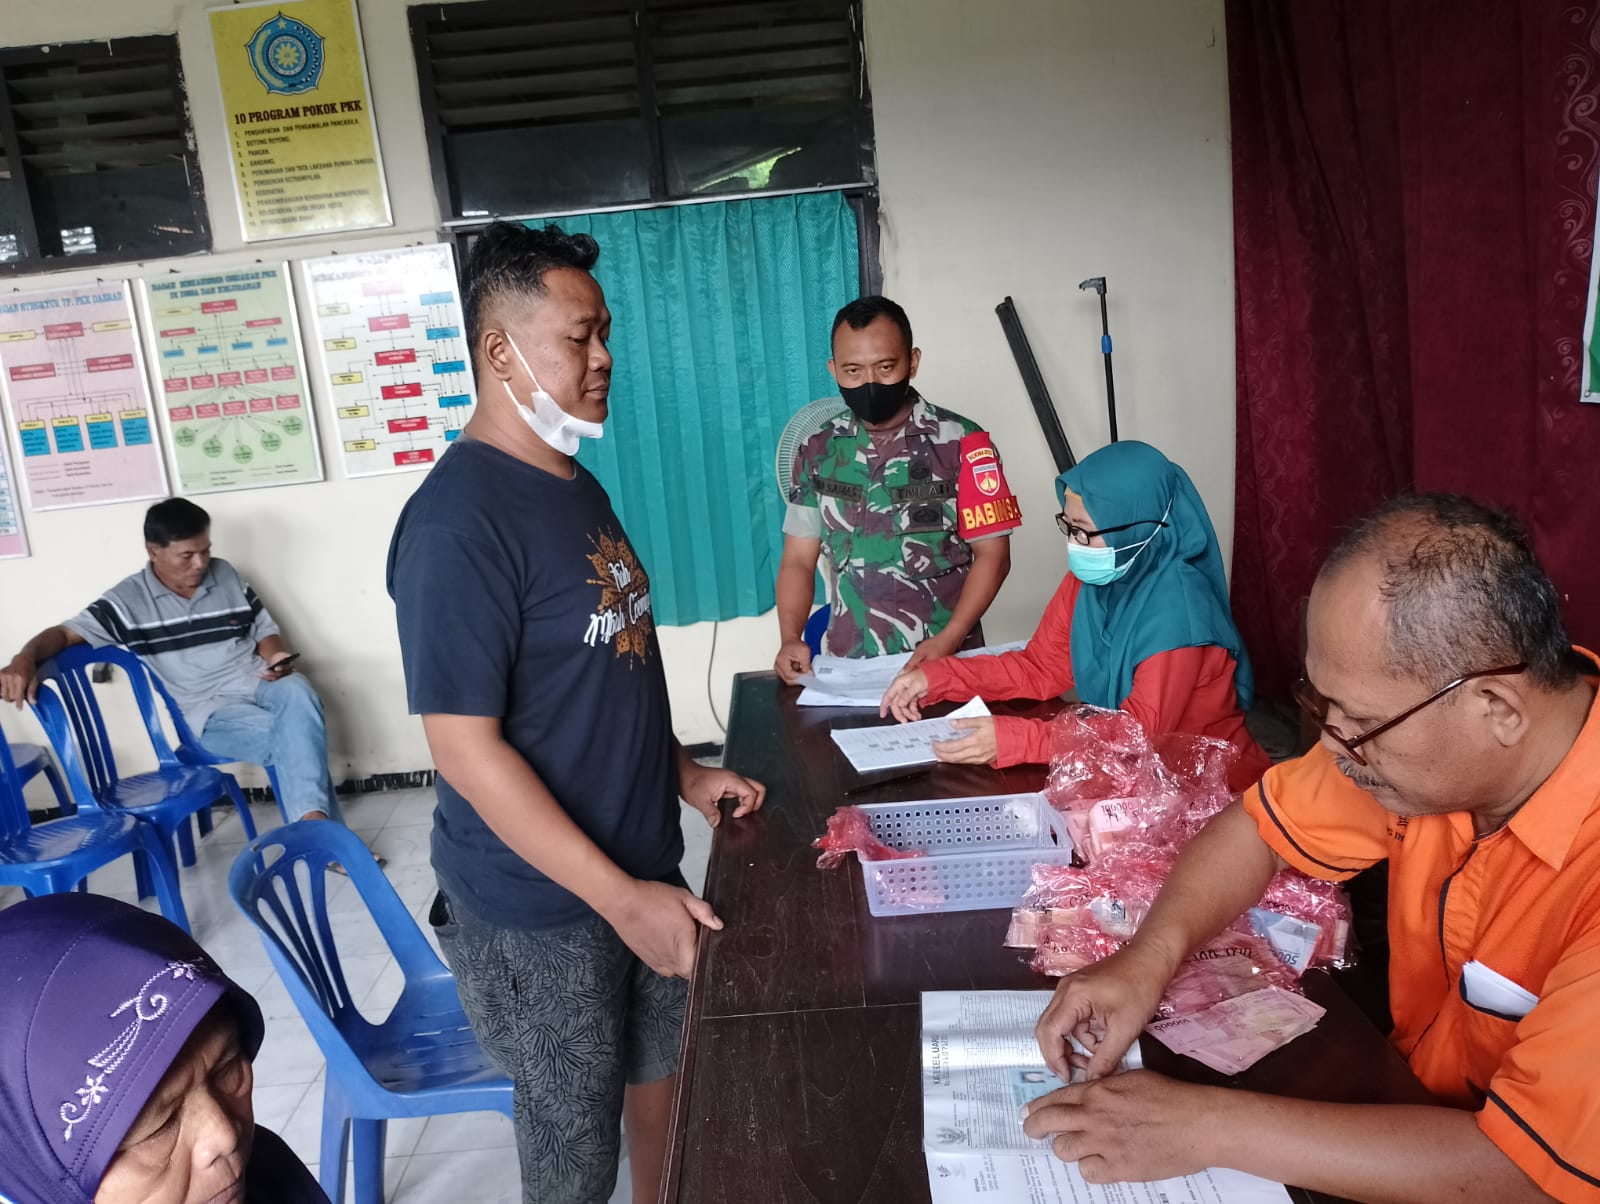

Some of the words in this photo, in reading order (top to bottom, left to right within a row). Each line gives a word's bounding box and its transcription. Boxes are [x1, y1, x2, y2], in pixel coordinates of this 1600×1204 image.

[235, 113, 246, 125] 10
[248, 107, 301, 123] PROGRAM
[302, 102, 338, 117] POKOK
[340, 100, 363, 112] PKK
[962, 497, 1021, 530] BABINSA
